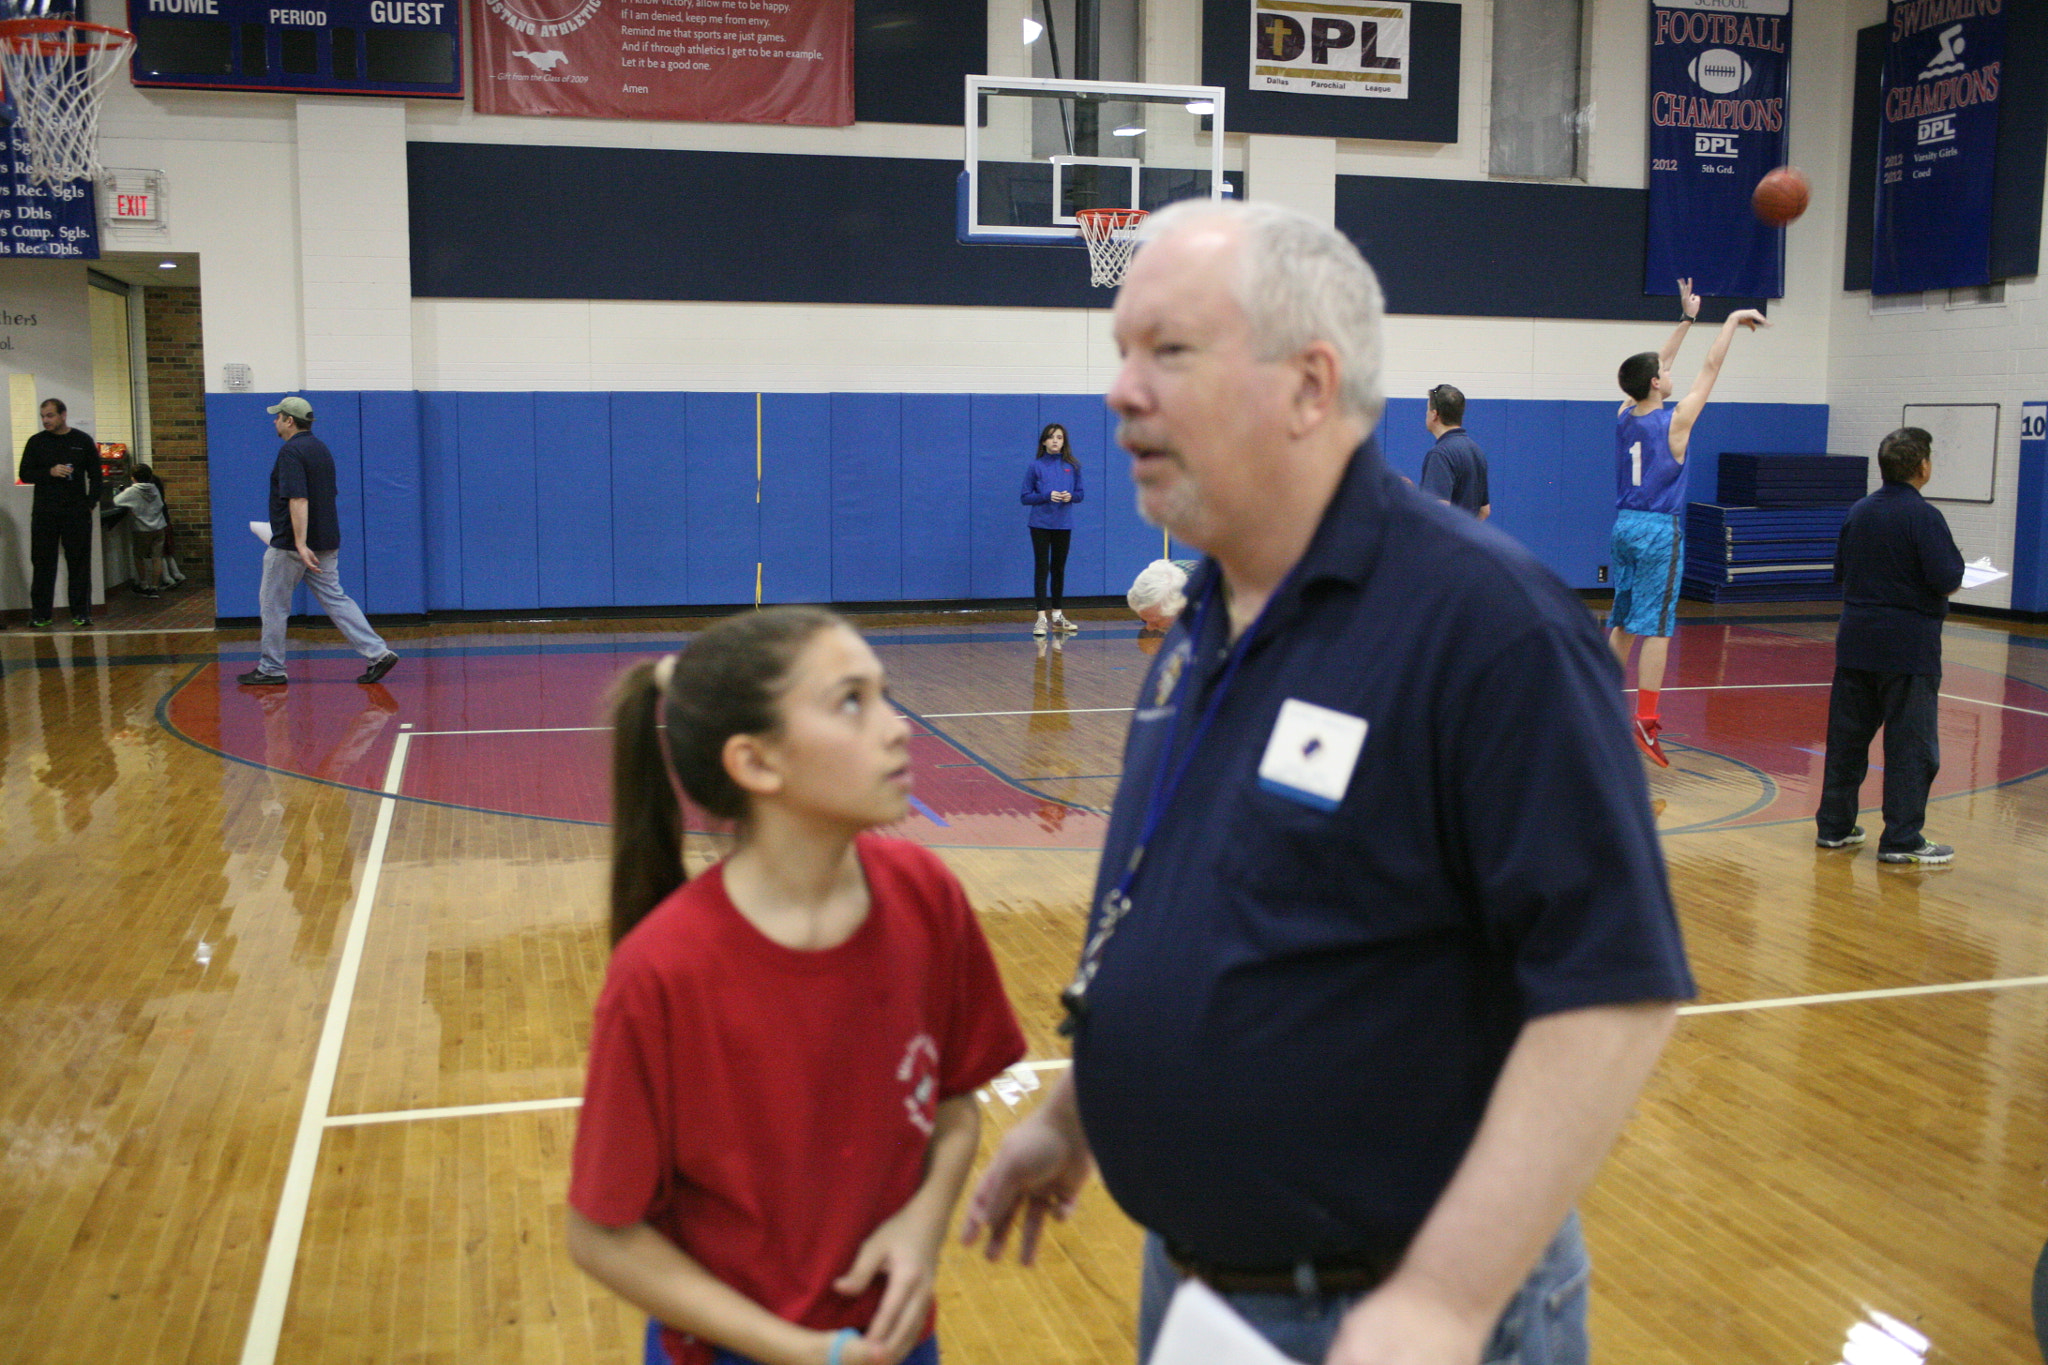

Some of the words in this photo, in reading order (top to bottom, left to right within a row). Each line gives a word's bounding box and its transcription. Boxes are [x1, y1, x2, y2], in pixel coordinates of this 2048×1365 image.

[370, 0, 445, 25] GUEST
[722, 0, 736, 8] me
[738, 0, 748, 9] to
[750, 0, 761, 10] be
[763, 2, 790, 14] happy.
[270, 9, 327, 26] PERIOD
[621, 9, 629, 19] If
[635, 12, 649, 20] am
[686, 12, 707, 26] keep
[709, 16, 723, 24] me
[725, 13, 747, 25] from
[748, 18, 771, 28] envy.
[621, 25, 656, 37] Remind
[657, 29, 672, 37] me
[673, 28, 692, 38] that
[694, 30, 721, 41] sports
[723, 32, 737, 40] are
[739, 31, 755, 43] just
[757, 34, 787, 44] games.
[1256, 12, 1401, 69] DPL
[1655, 10, 1785, 54] FOOTBALL
[622, 41, 640, 52] And
[642, 41, 650, 52] if
[651, 42, 685, 56] through
[688, 43, 725, 55] athletics
[732, 48, 747, 58] get
[748, 49, 758, 57] to
[760, 47, 771, 57] be
[773, 50, 784, 58] an
[622, 57, 636, 67] Let
[638, 58, 646, 68] it
[647, 57, 659, 68] be
[660, 61, 666, 69] a
[668, 59, 691, 72] good
[692, 62, 712, 71] one.
[498, 72, 511, 81] Gift
[512, 73, 529, 81] from
[530, 74, 542, 82] the
[543, 74, 561, 83] Class
[561, 75, 569, 83] of
[1266, 77, 1289, 86] Dallas
[1311, 80, 1346, 90] Parochial
[1365, 84, 1391, 93] League
[622, 83, 649, 94] Amen
[1886, 61, 2000, 123] CHAMPIONS
[1652, 91, 1783, 132] CHAMPIONS
[1917, 119, 1956, 141] DPL
[1695, 136, 1739, 154] DPL
[1652, 158, 1678, 171] 2012
[1702, 164, 1715, 173] 5th
[16, 184, 47, 197] Rec.
[54, 184, 84, 201] Sgls
[17, 206, 52, 220] Dbls
[117, 195, 148, 217] EXIT
[12, 225, 54, 241] Comp.
[59, 226, 90, 241] Sgls.
[16, 242, 44, 254] Rec.
[49, 242, 82, 255] Dbls.
[0, 310, 38, 326] hers
[2021, 415, 2046, 437] 10
[1629, 441, 1642, 487] 1
